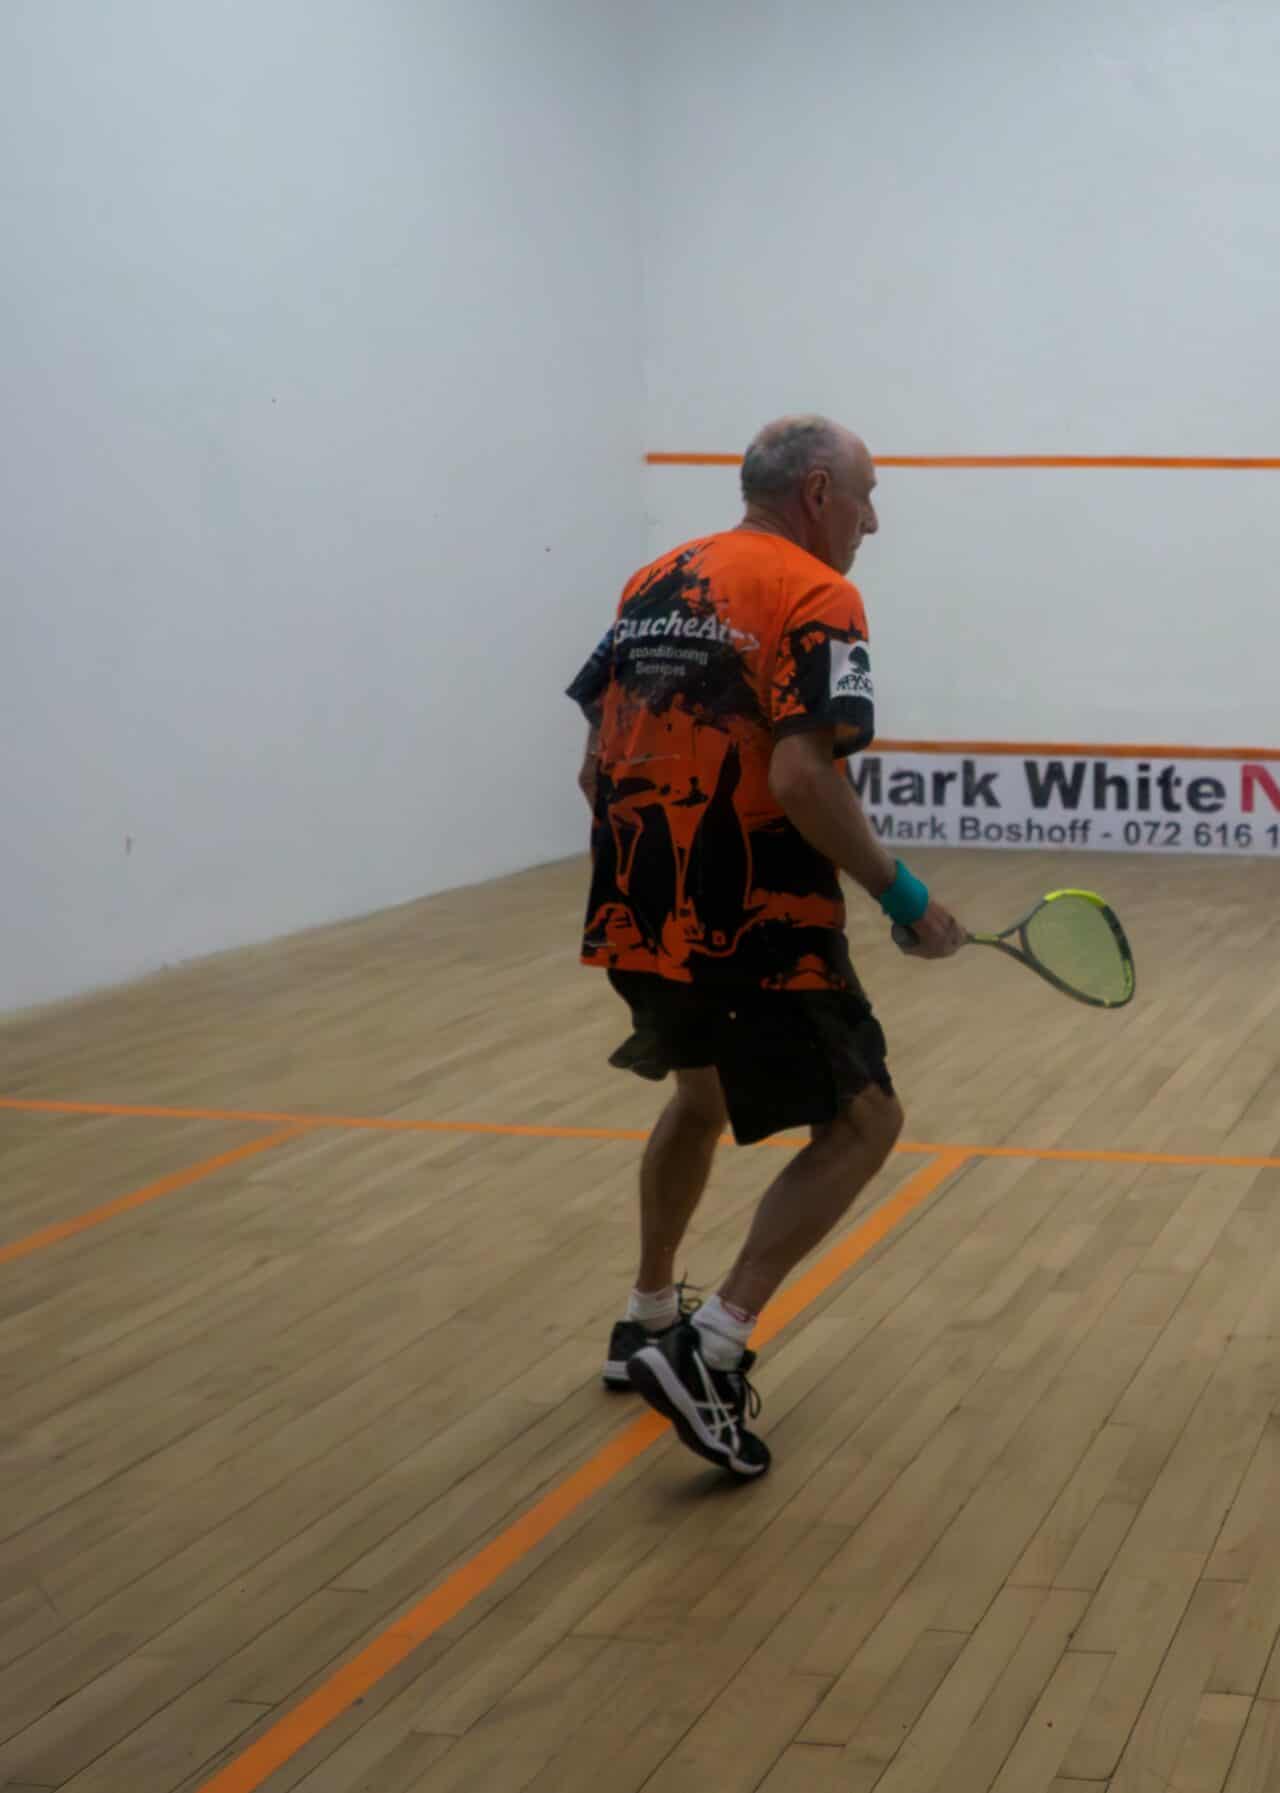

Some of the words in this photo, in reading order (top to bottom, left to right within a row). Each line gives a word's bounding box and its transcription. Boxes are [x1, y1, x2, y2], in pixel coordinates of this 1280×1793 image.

[846, 757, 1001, 808] Mark
[1024, 760, 1226, 814] White
[870, 814, 947, 840] Mark
[960, 816, 1092, 844] Boshoff
[1123, 820, 1182, 847] 072
[1194, 823, 1253, 849] 616
